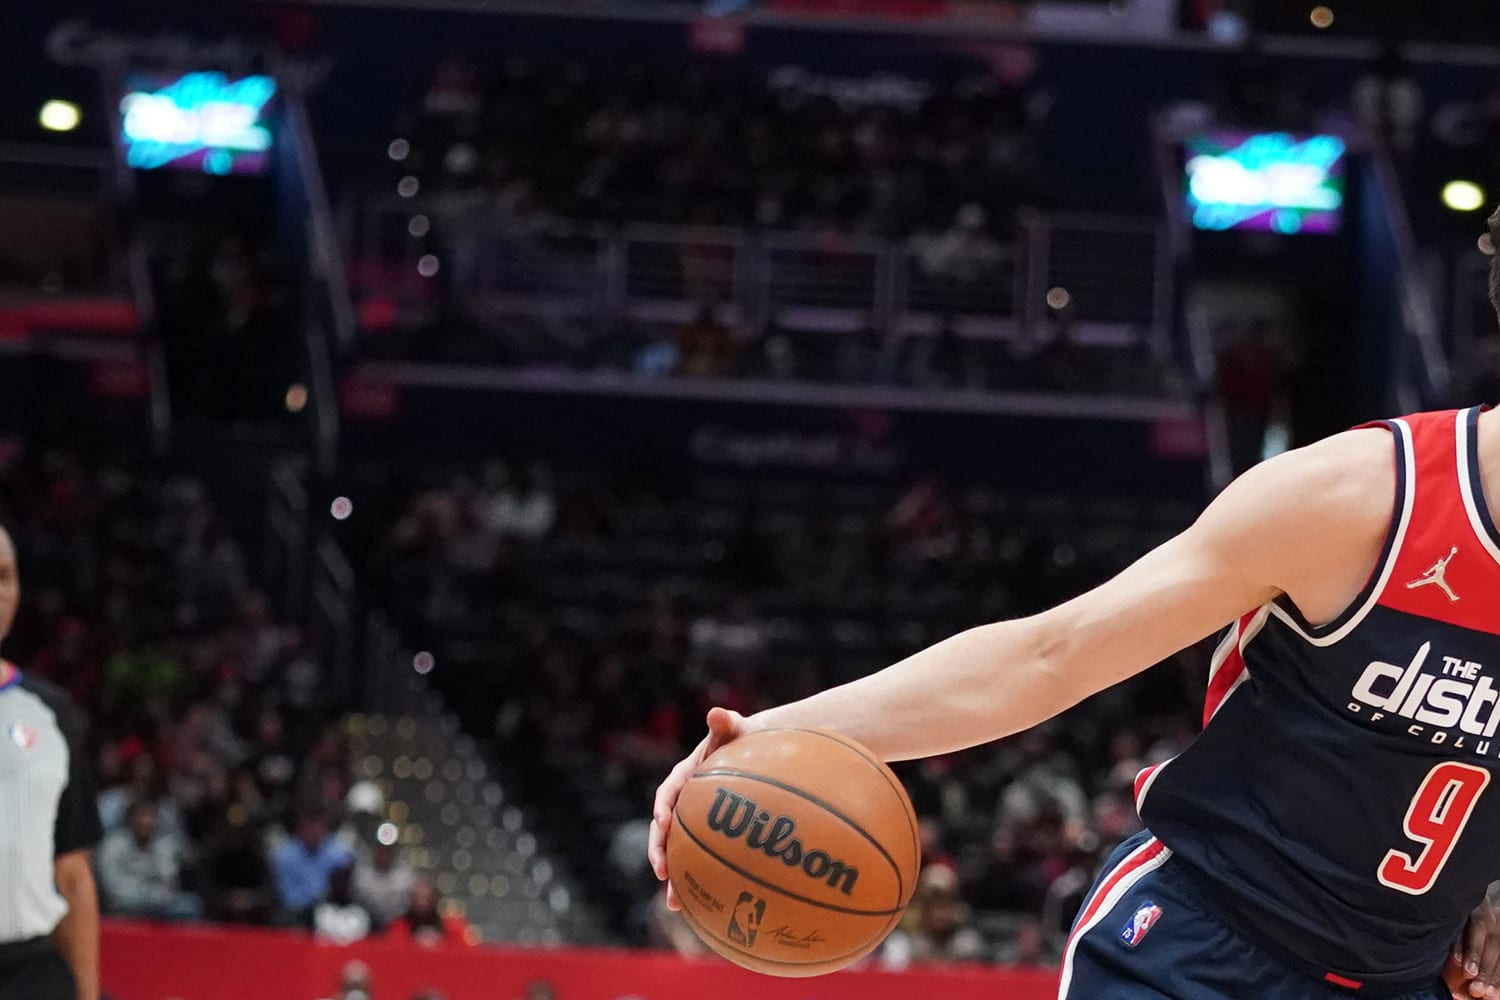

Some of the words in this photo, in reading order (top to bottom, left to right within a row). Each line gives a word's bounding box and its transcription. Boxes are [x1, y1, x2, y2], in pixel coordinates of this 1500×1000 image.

[1442, 656, 1482, 681] THE
[1347, 702, 1385, 722] OF
[707, 787, 859, 896] Wilson
[1377, 761, 1491, 895] 9
